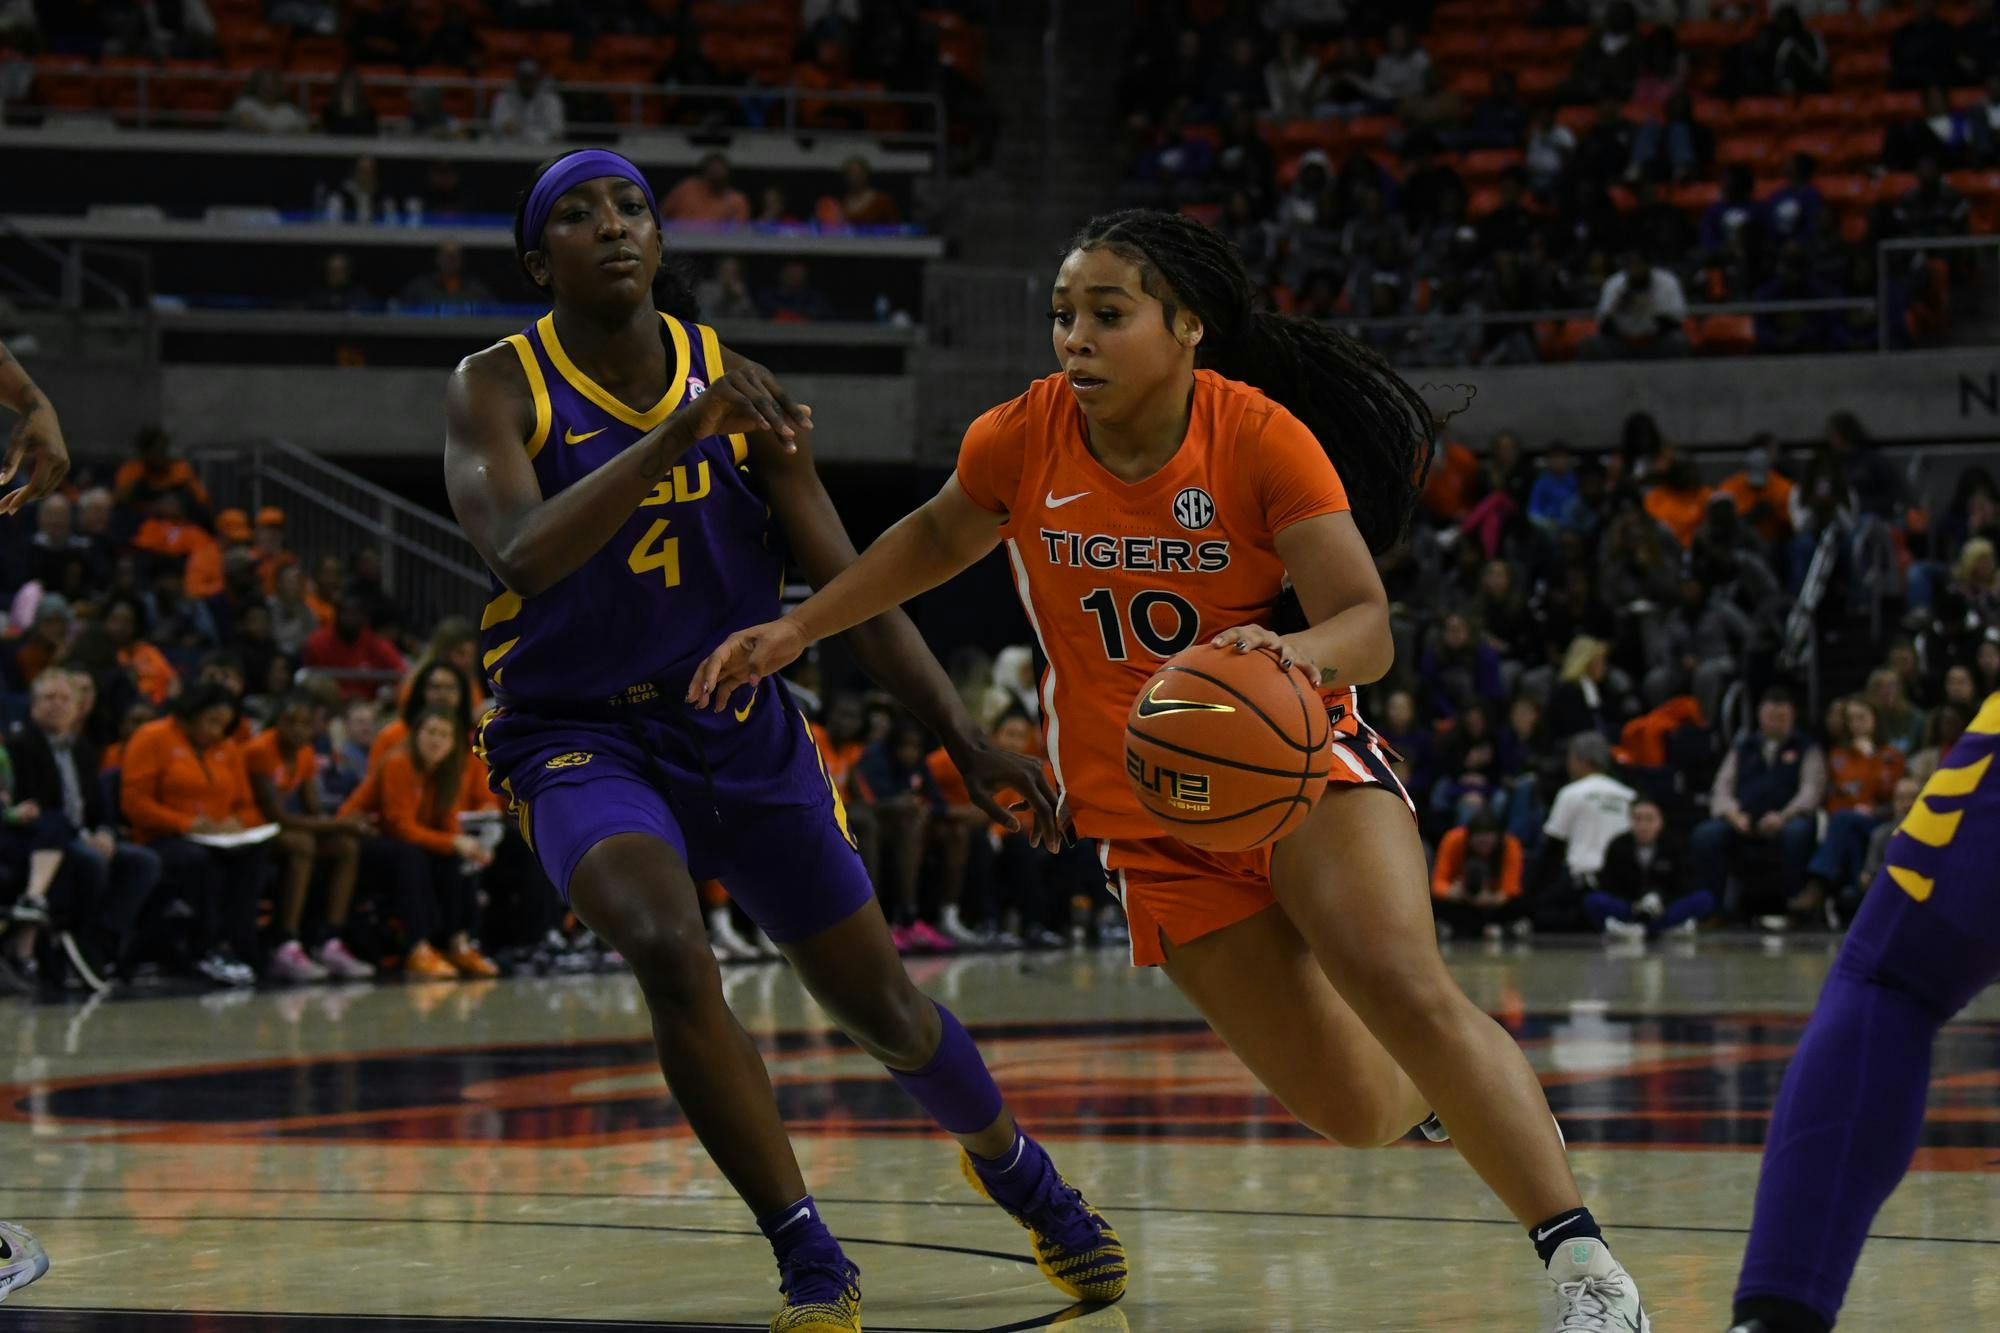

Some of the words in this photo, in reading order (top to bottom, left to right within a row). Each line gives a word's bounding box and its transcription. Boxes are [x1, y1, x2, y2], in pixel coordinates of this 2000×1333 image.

[639, 460, 711, 507] SU
[1175, 490, 1213, 529] SEC
[627, 517, 680, 589] 4
[1040, 527, 1231, 573] TIGERS
[1080, 588, 1200, 661] 10
